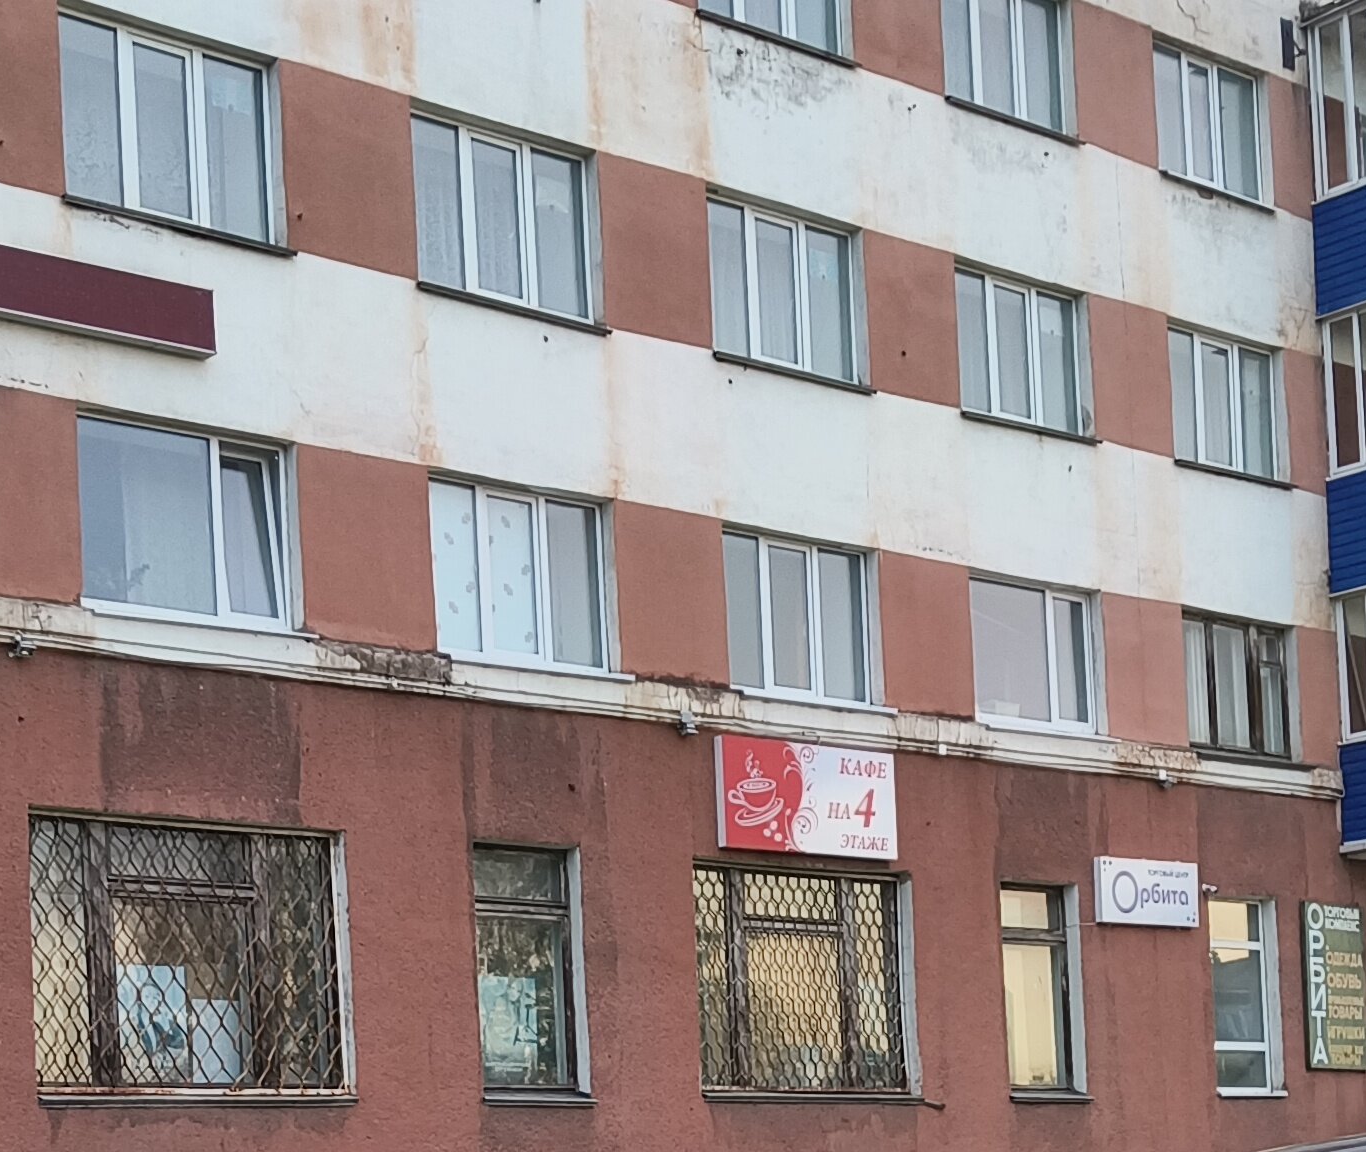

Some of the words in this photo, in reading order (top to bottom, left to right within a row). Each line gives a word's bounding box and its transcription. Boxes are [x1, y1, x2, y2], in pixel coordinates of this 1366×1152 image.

[839, 757, 887, 780] КАФЕ
[826, 801, 852, 822] НА
[853, 787, 877, 829] 4
[839, 833, 890, 853] ЭТАЖЕ
[1111, 870, 1190, 914] Орбита
[1326, 952, 1363, 967] ОДЕЖДА
[1307, 903, 1329, 1064] ОРБИТА
[1327, 973, 1361, 988] ОБУВЬ
